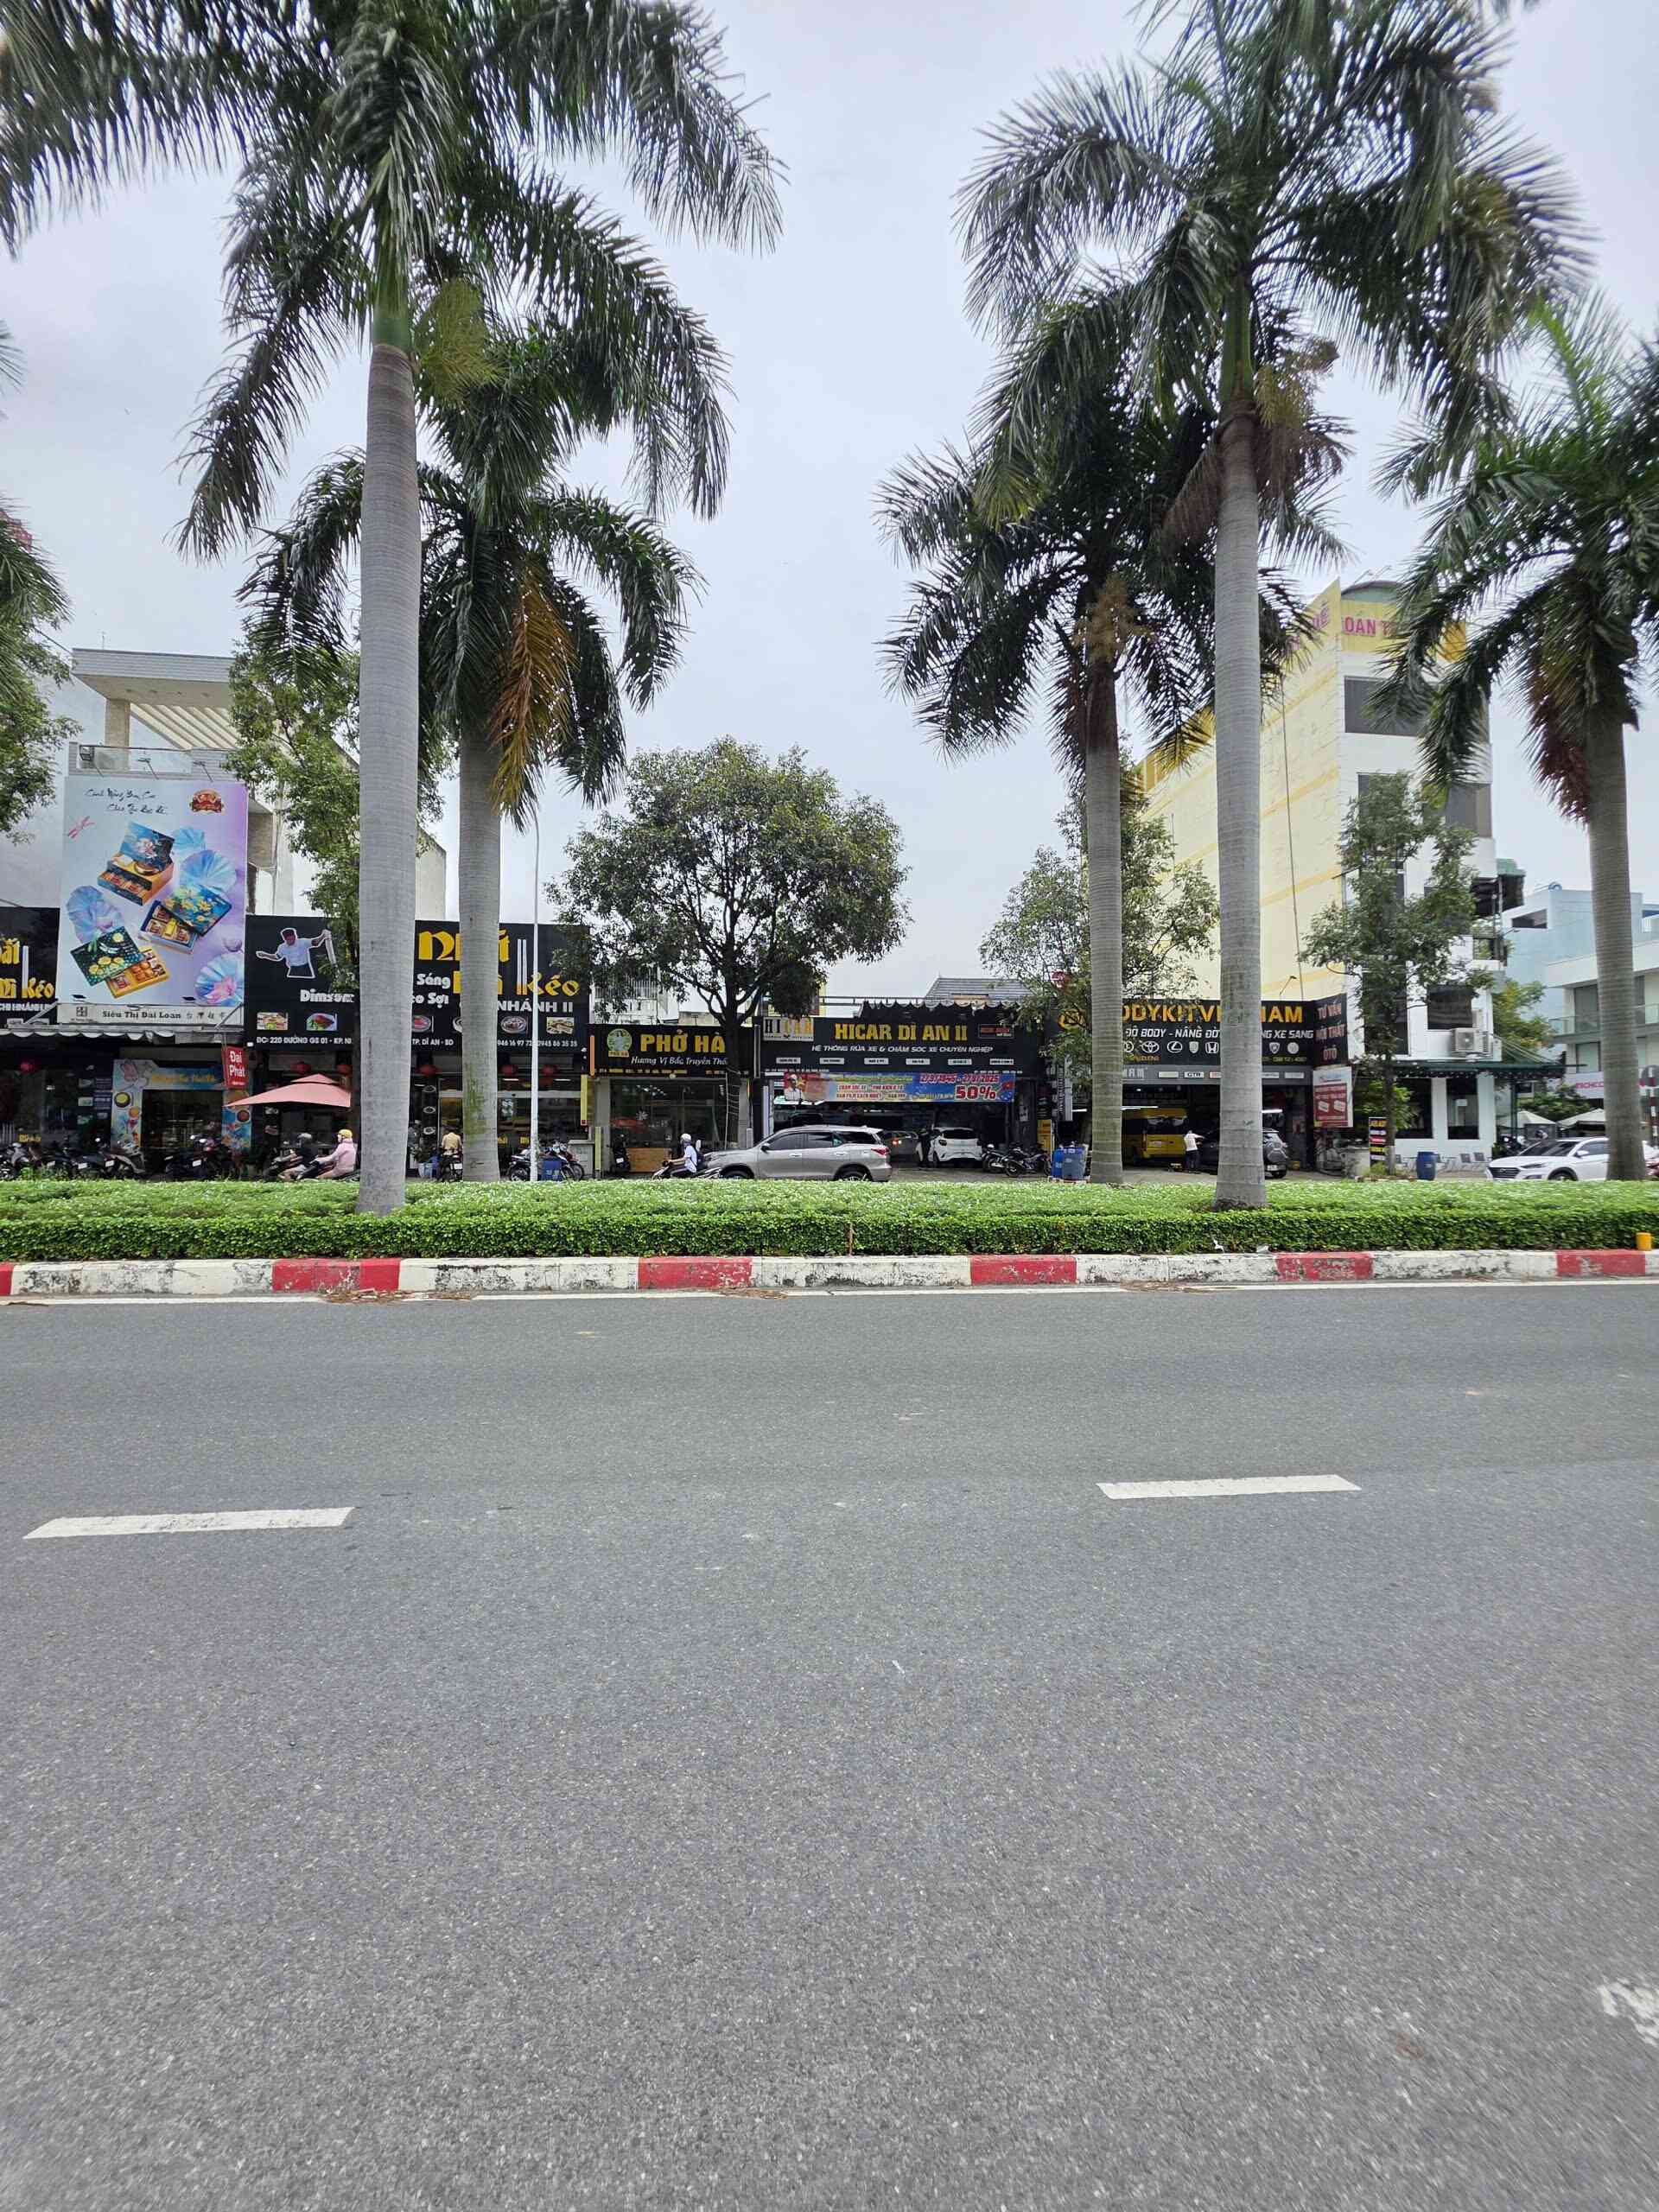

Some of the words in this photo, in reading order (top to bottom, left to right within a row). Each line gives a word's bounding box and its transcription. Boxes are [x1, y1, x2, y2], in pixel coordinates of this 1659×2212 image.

[416, 973, 451, 988] Sáng
[640, 1027, 689, 1052] PHỞ
[694, 1032, 726, 1053] HÀ
[835, 1023, 892, 1040] HICAR
[922, 1024, 950, 1041] AN
[955, 1025, 969, 1041] II
[1141, 1028, 1166, 1038] BODY
[1273, 1029, 1287, 1039] XE
[1288, 1029, 1313, 1039] SANG
[955, 1084, 997, 1100] 50%
